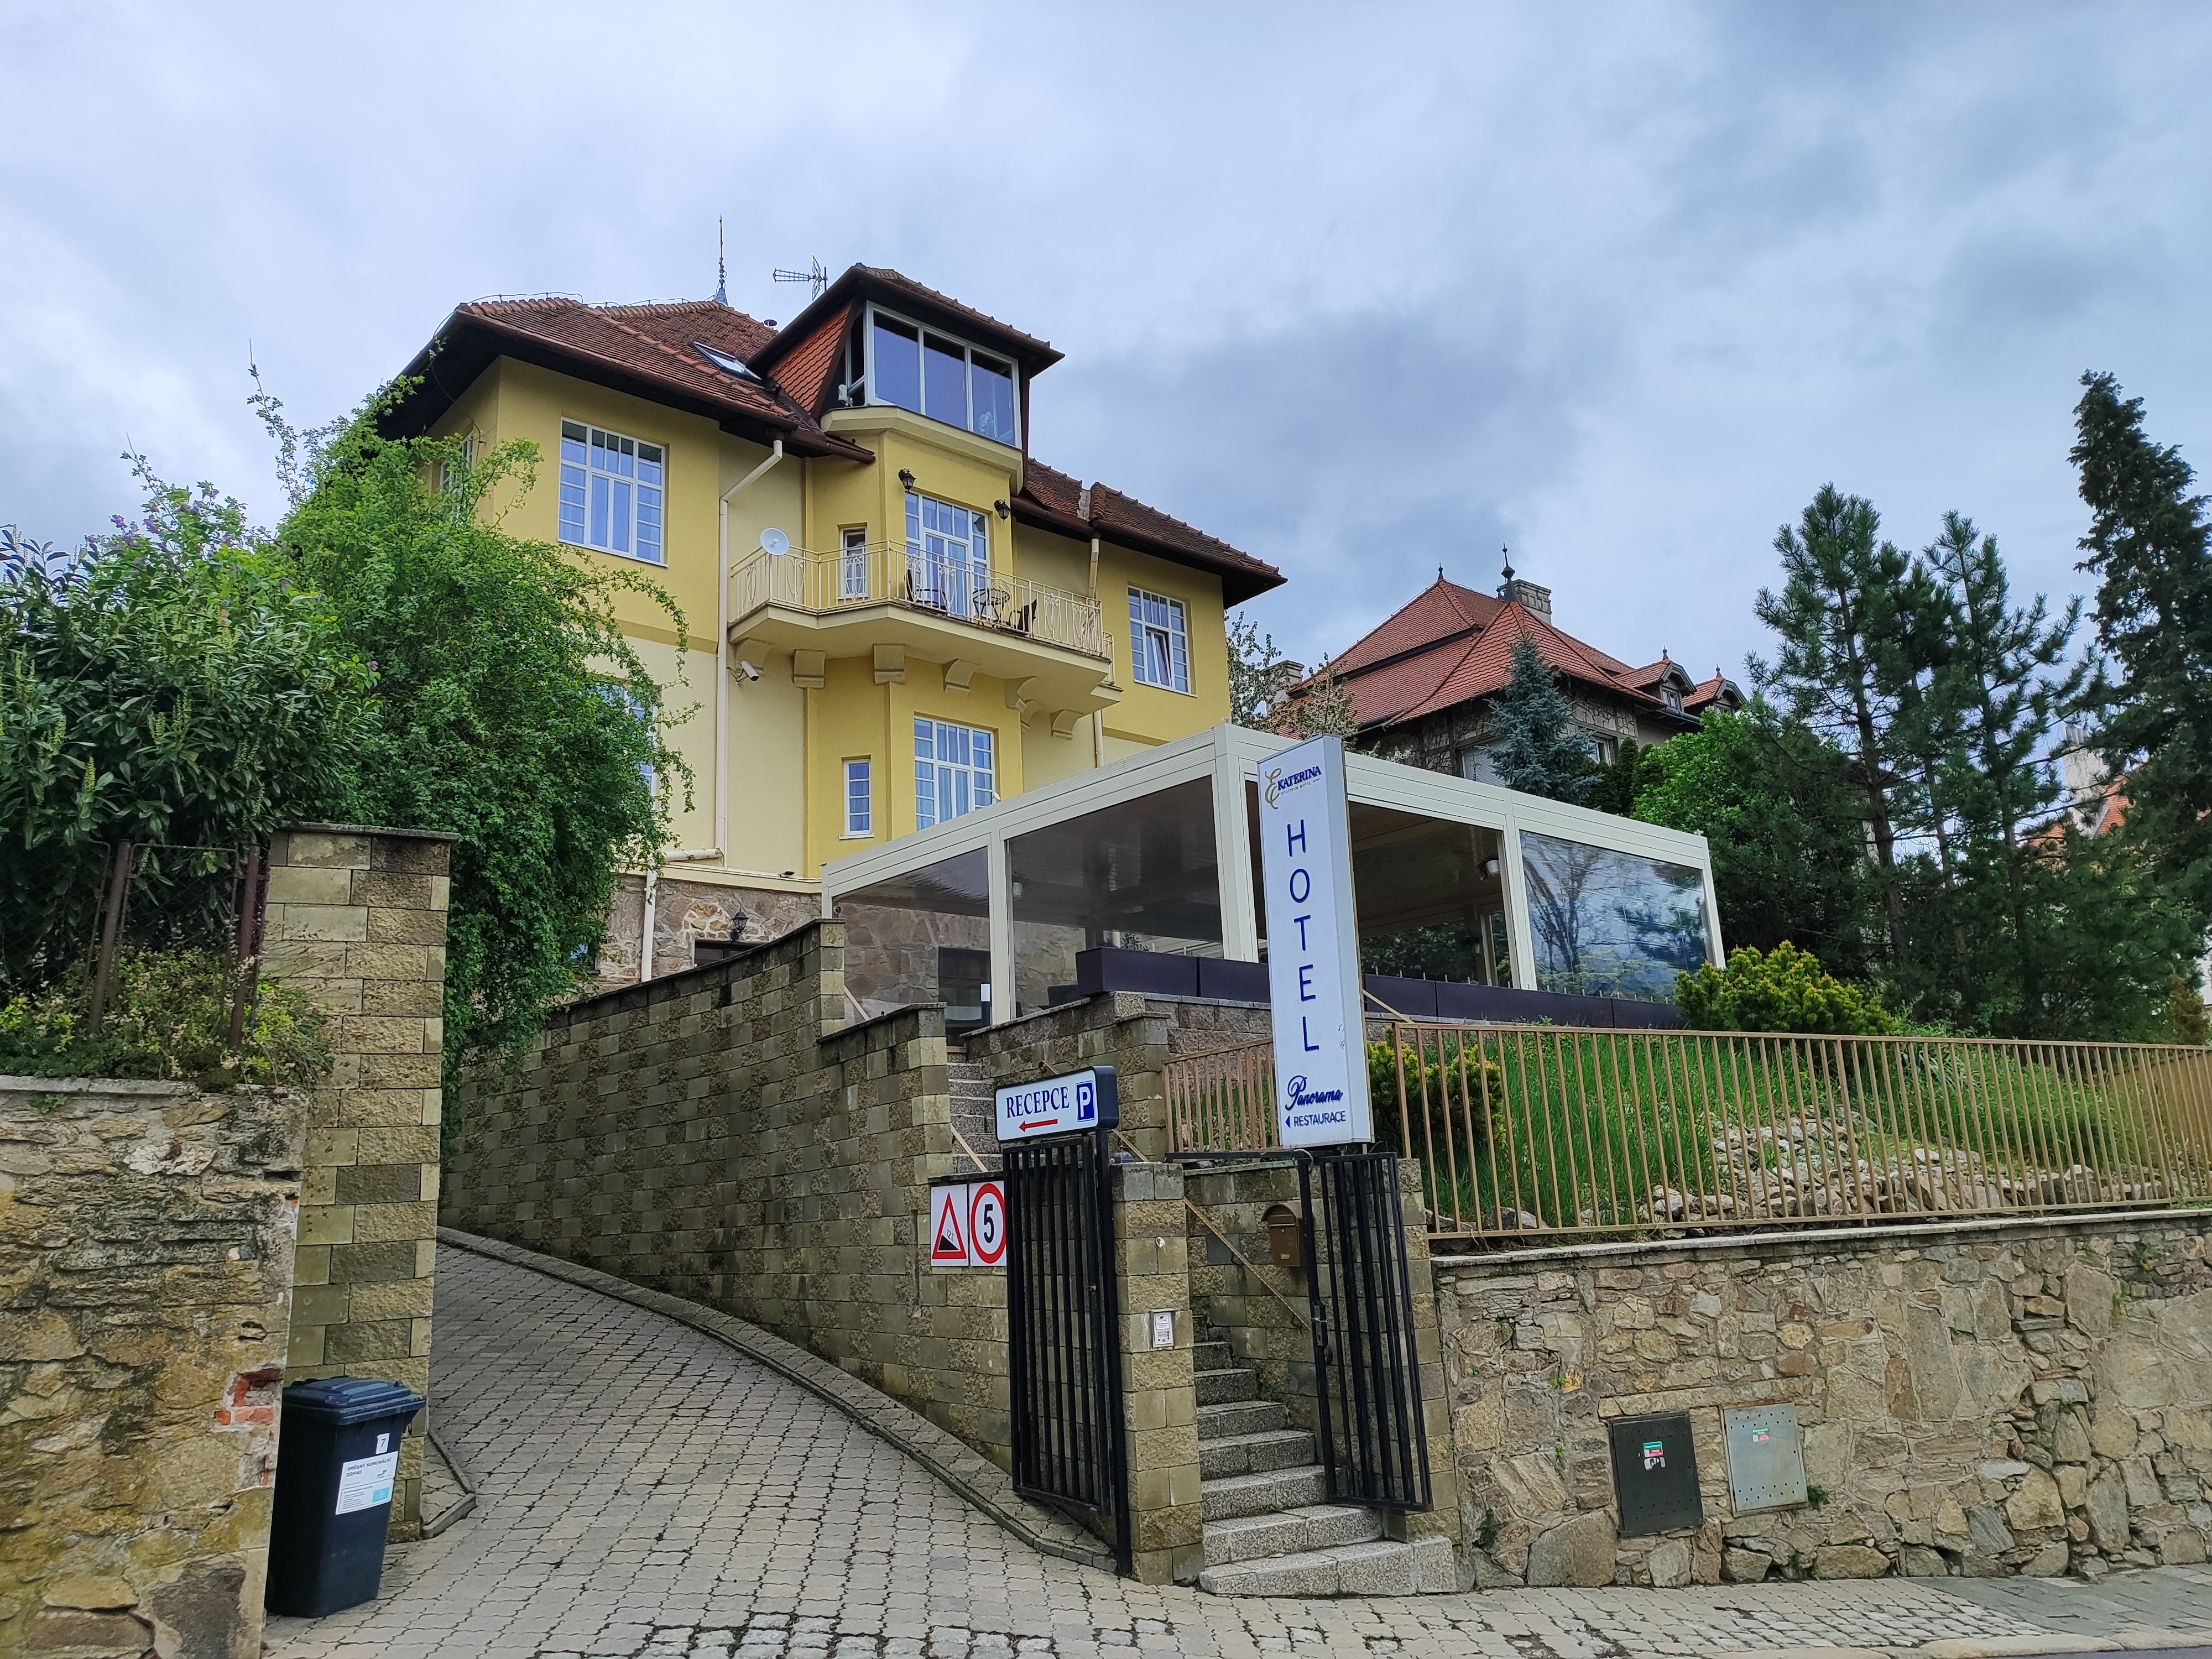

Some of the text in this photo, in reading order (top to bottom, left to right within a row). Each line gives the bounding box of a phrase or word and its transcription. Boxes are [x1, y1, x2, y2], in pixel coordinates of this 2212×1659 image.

[1286, 819, 1320, 1052] HOTEL
[1005, 1086, 1092, 1118] RECEPCE P
[1285, 1075, 1344, 1111] Panorama
[1293, 1110, 1347, 1128] RESTAURACE
[983, 1203, 994, 1244] 5
[381, 1438, 387, 1448] 7
[347, 1457, 392, 1471] SMĚSNÝ KOMUNÁLNÍ
